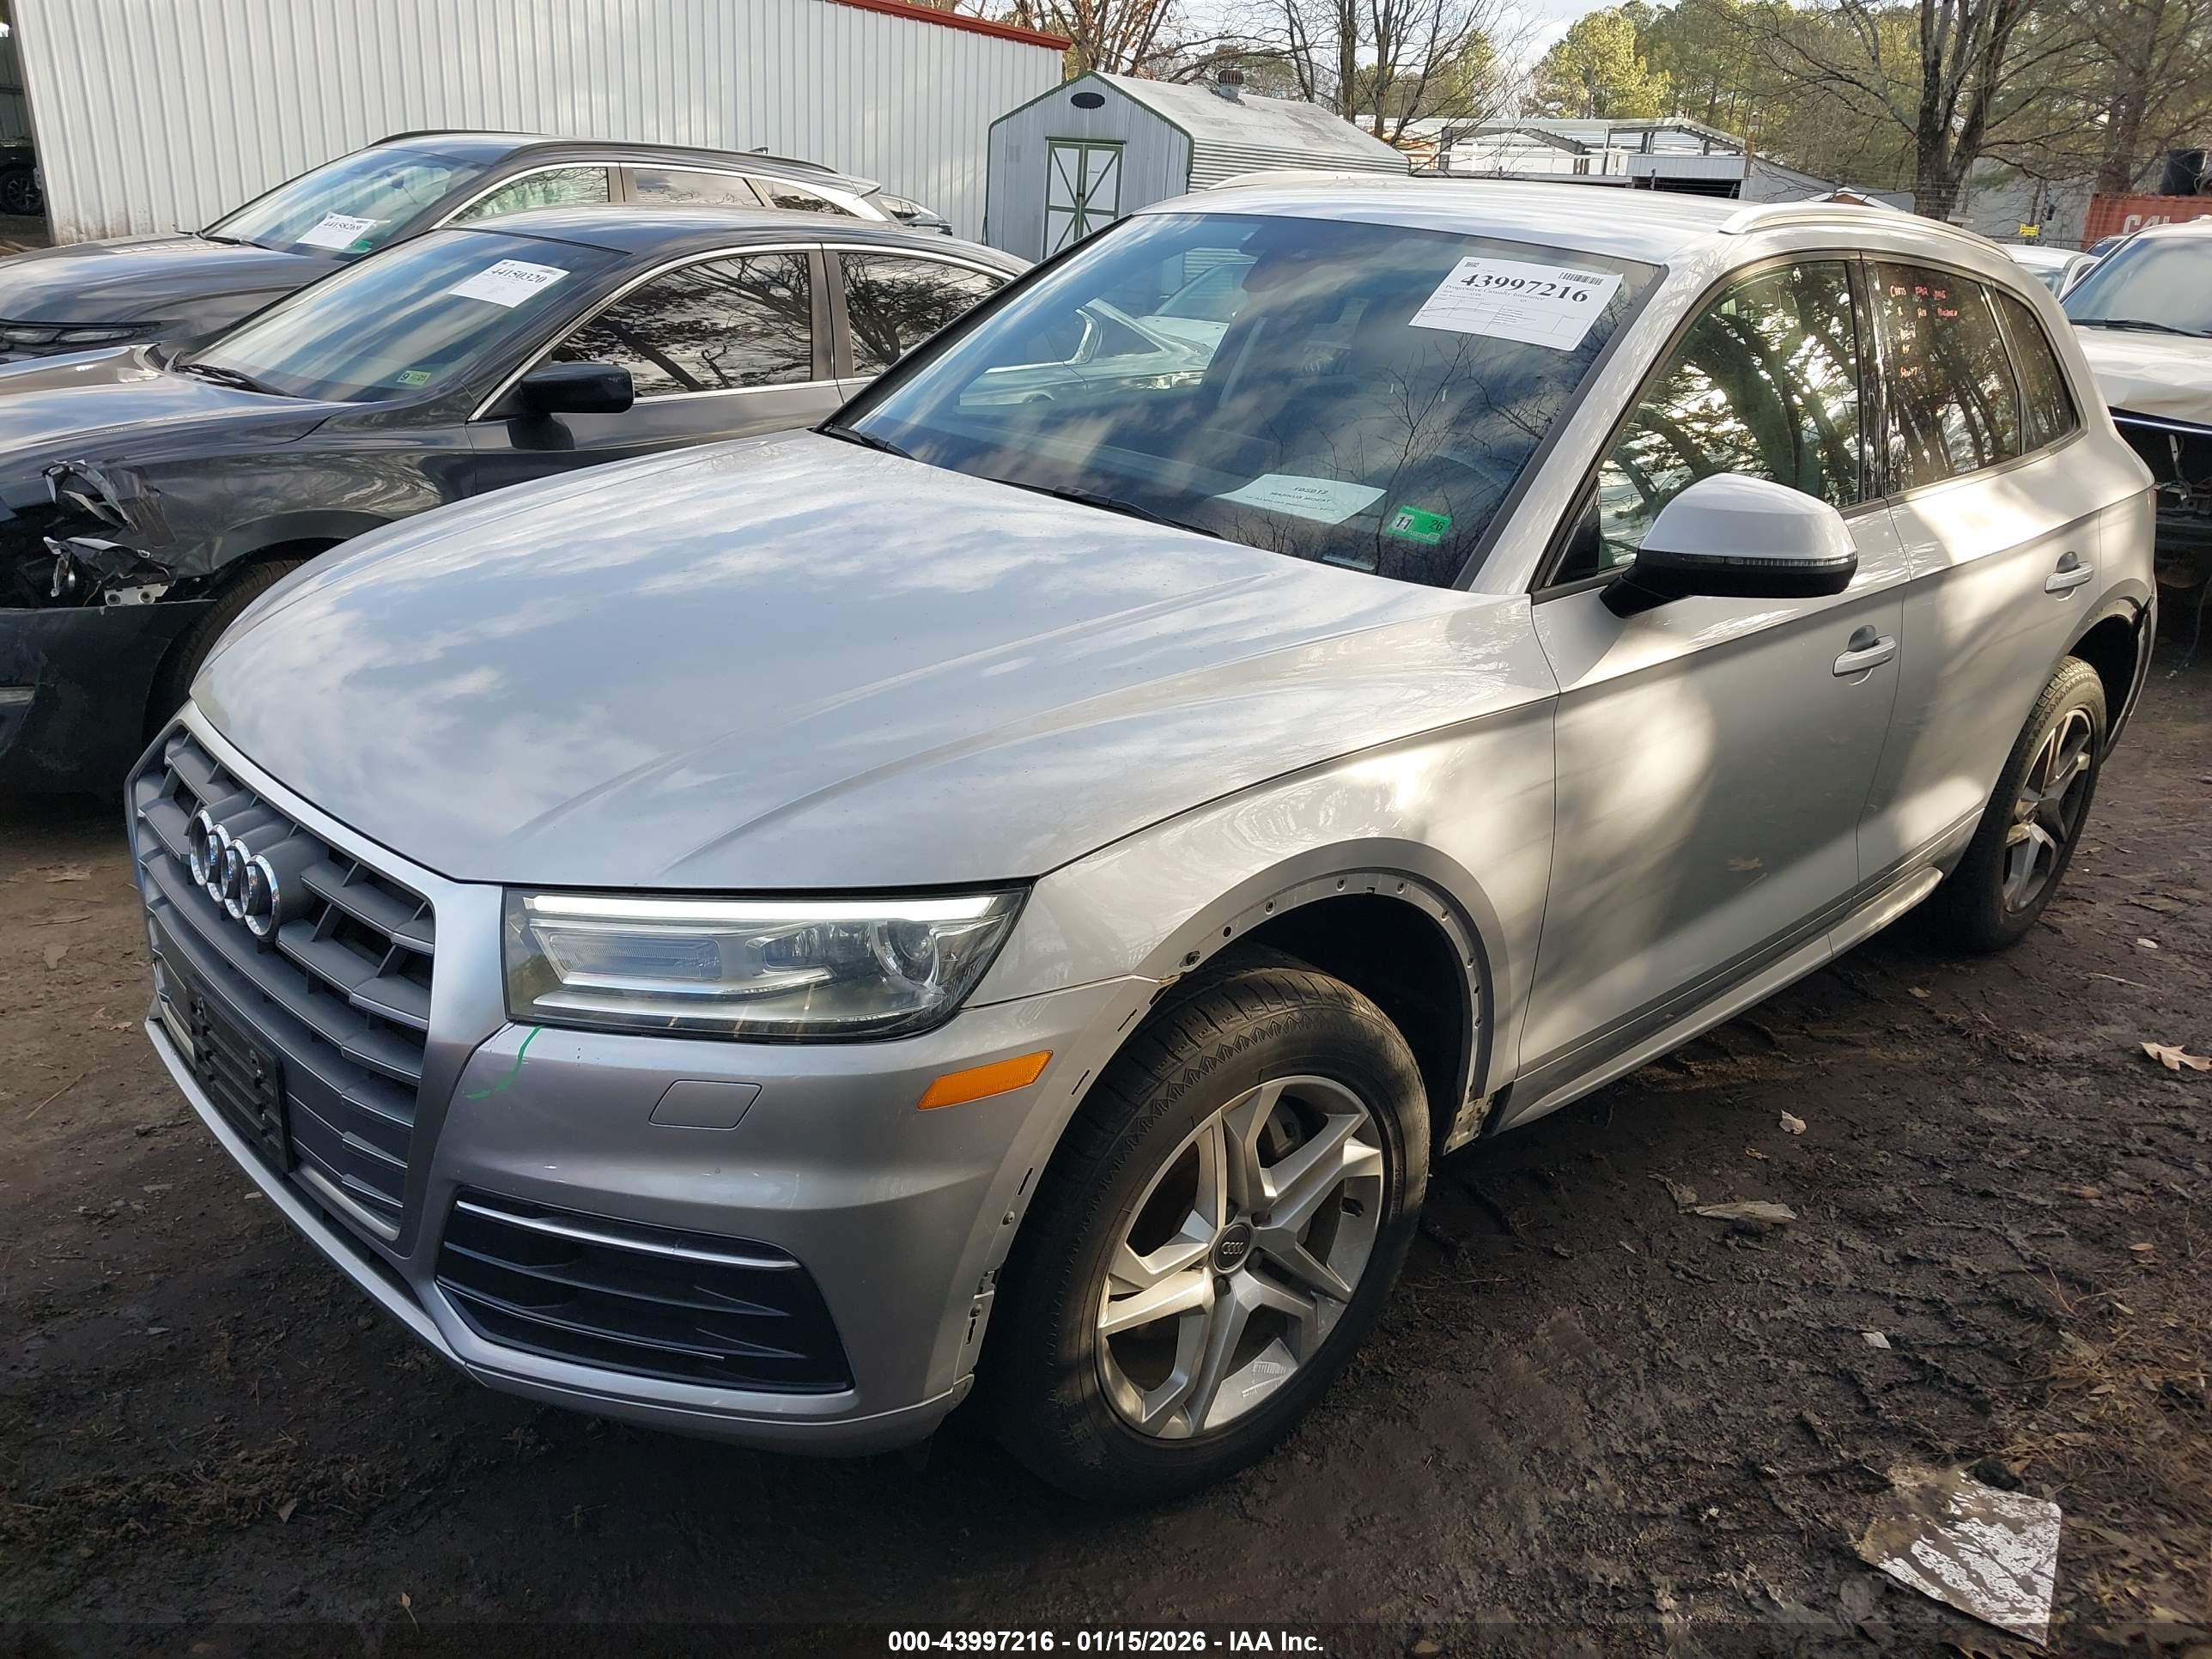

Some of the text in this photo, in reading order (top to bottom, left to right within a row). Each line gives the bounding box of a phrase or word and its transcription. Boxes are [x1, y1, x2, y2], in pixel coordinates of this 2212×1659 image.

[1444, 284, 1482, 293] Progressive
[1483, 288, 1512, 296] Casualty
[1512, 292, 1547, 301] Insurance
[1460, 273, 1595, 302] 43997216
[1395, 515, 1446, 532] 11 26
